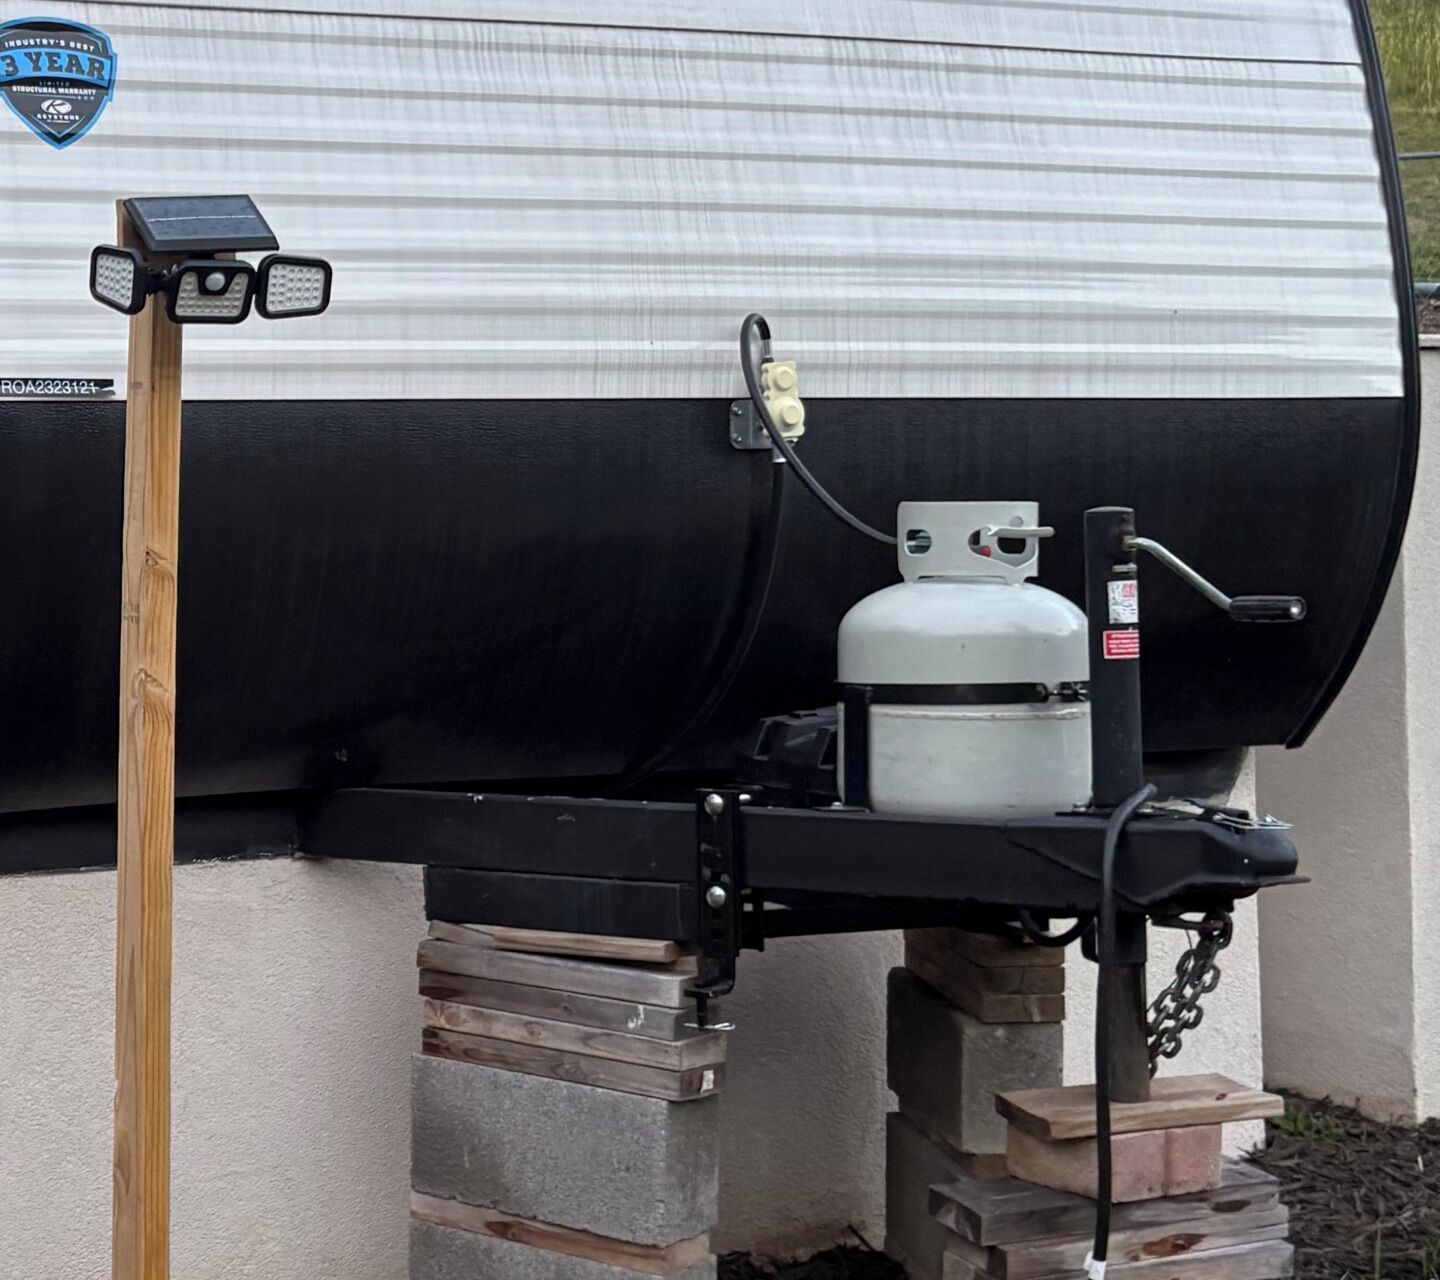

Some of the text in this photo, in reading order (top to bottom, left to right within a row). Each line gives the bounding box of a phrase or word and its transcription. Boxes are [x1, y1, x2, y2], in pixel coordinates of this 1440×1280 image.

[4, 37, 95, 52] INDUSTRY'S BEST
[0, 51, 105, 81] 3 YEAR
[12, 85, 97, 96] STRUCTURAL WARRANTY
[36, 113, 80, 121] KEYSTONE
